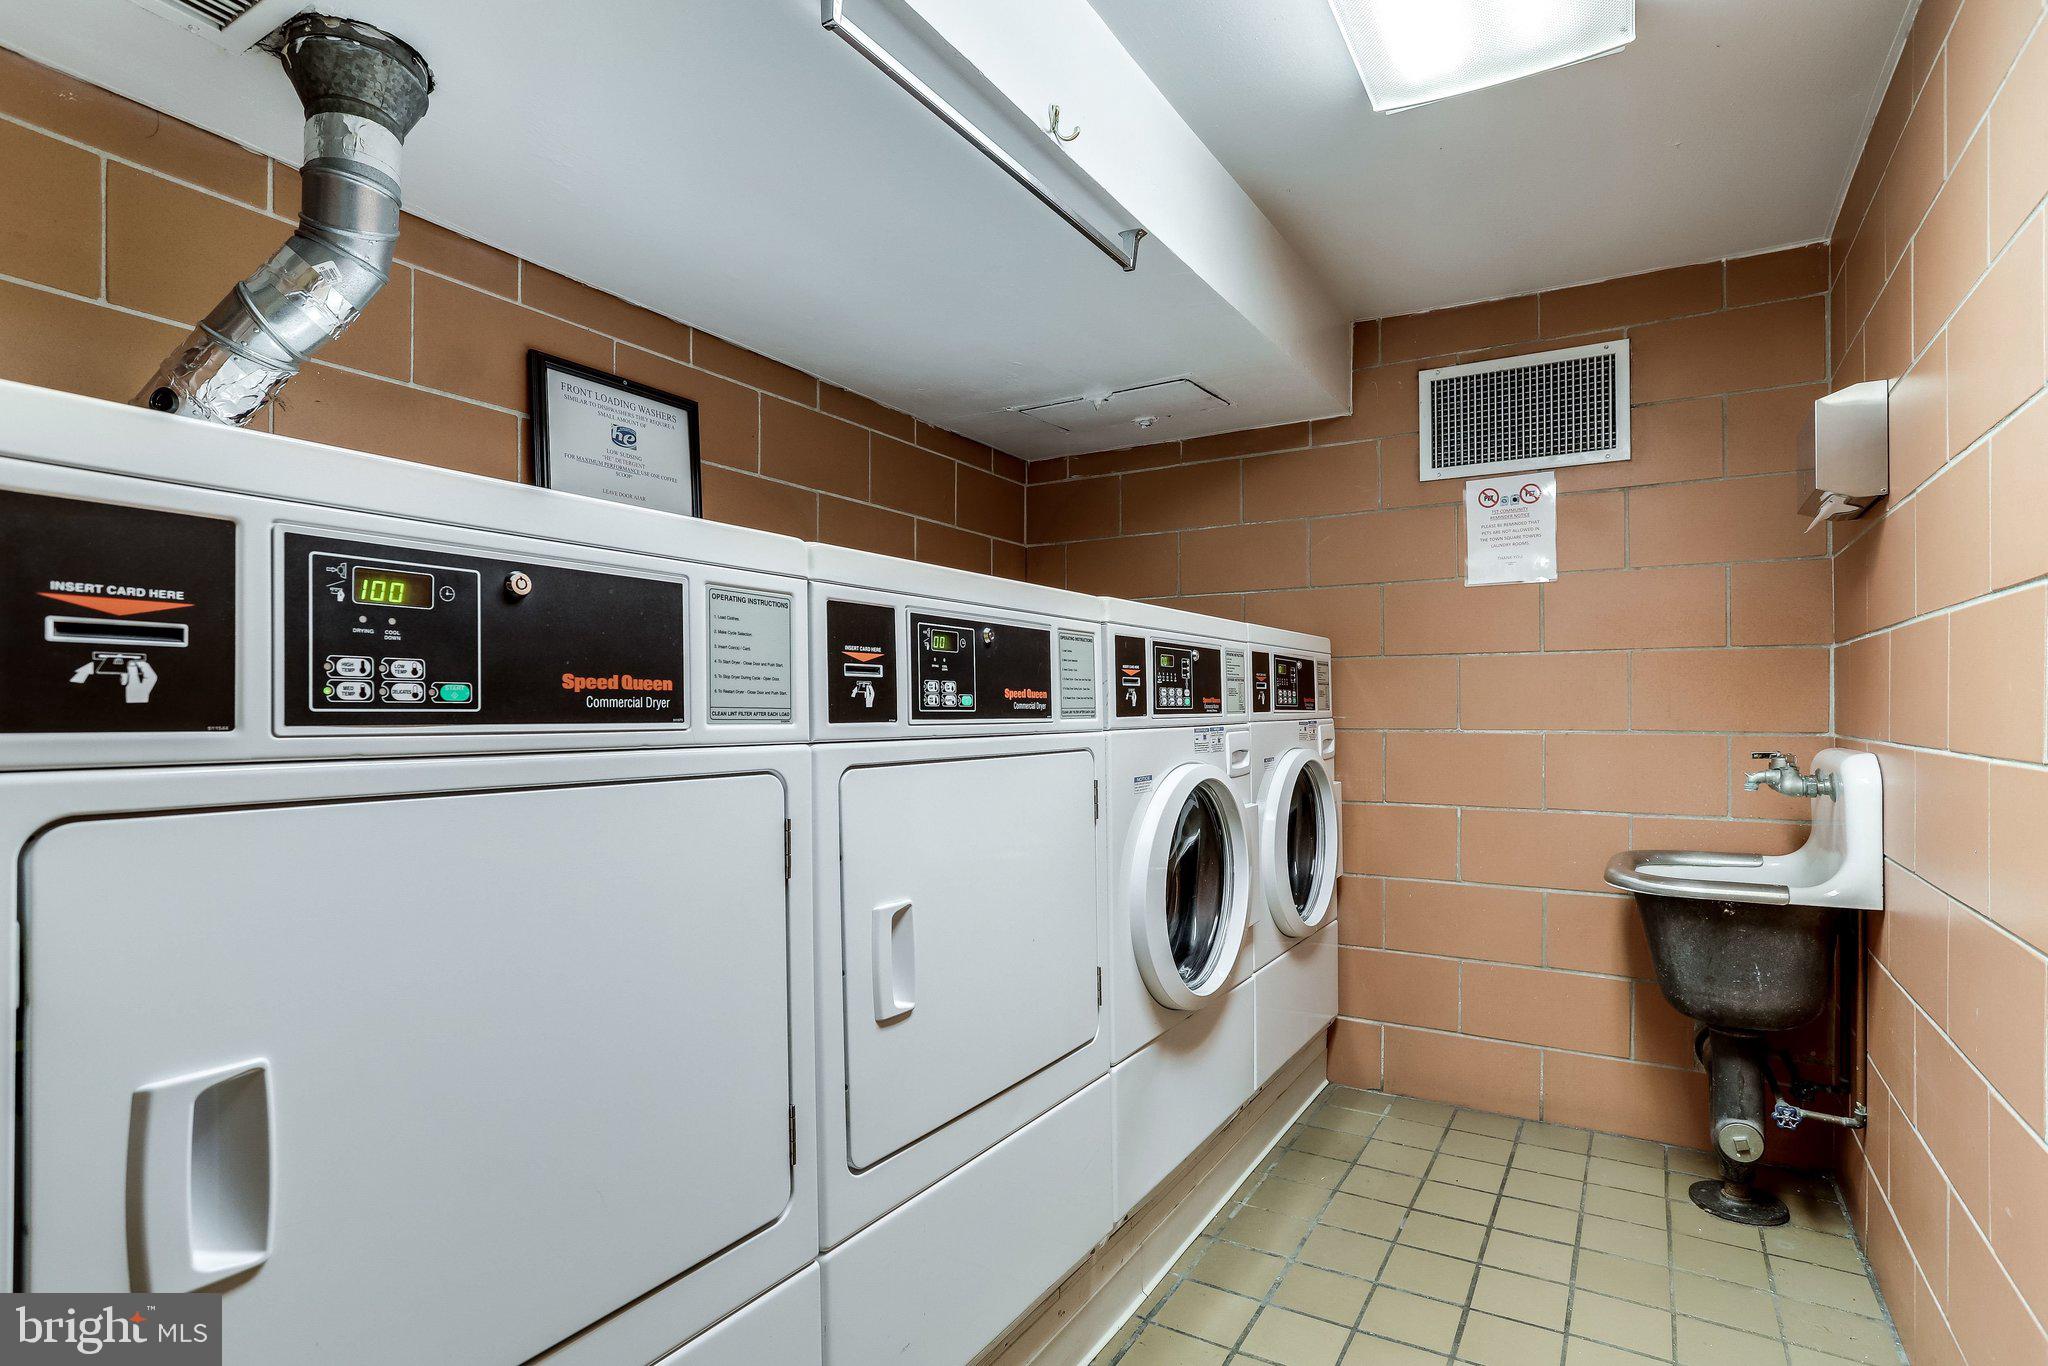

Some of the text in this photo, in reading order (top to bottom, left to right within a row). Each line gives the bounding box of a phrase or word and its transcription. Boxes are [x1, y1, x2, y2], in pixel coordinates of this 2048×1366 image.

[561, 382, 677, 423] FRONT LOADING WASHERS
[564, 394, 588, 406] SIMILAR
[602, 488, 617, 497] LEAVE
[619, 491, 633, 499] DOOR
[50, 580, 185, 600] INSERT CARD HERE
[361, 579, 404, 603] 100
[711, 593, 789, 609] OPERATING INSTRUCTIONS
[562, 673, 673, 692] Speed Queen
[1004, 688, 1047, 700] Speed Queen
[586, 695, 671, 711] Commercial Dryer
[1013, 701, 1035, 710] Commercial
